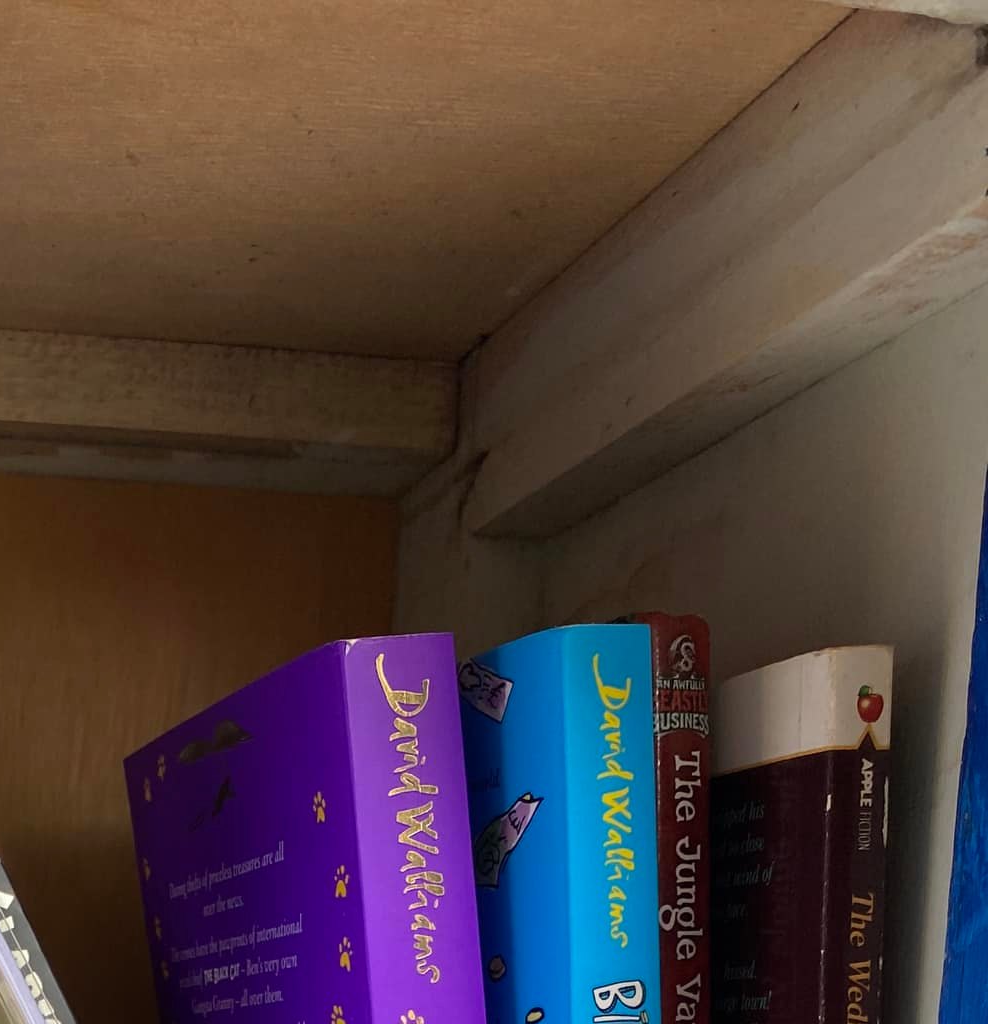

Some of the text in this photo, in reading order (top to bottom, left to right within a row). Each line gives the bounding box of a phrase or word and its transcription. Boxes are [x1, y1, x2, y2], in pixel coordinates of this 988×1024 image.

[375, 652, 445, 984] David Walliams
[592, 653, 635, 949] David Walliams
[674, 750, 701, 822] The
[858, 758, 874, 851] APPLE FICTION
[256, 913, 302, 943] international
[658, 836, 703, 960] Jungle
[849, 892, 874, 947] The
